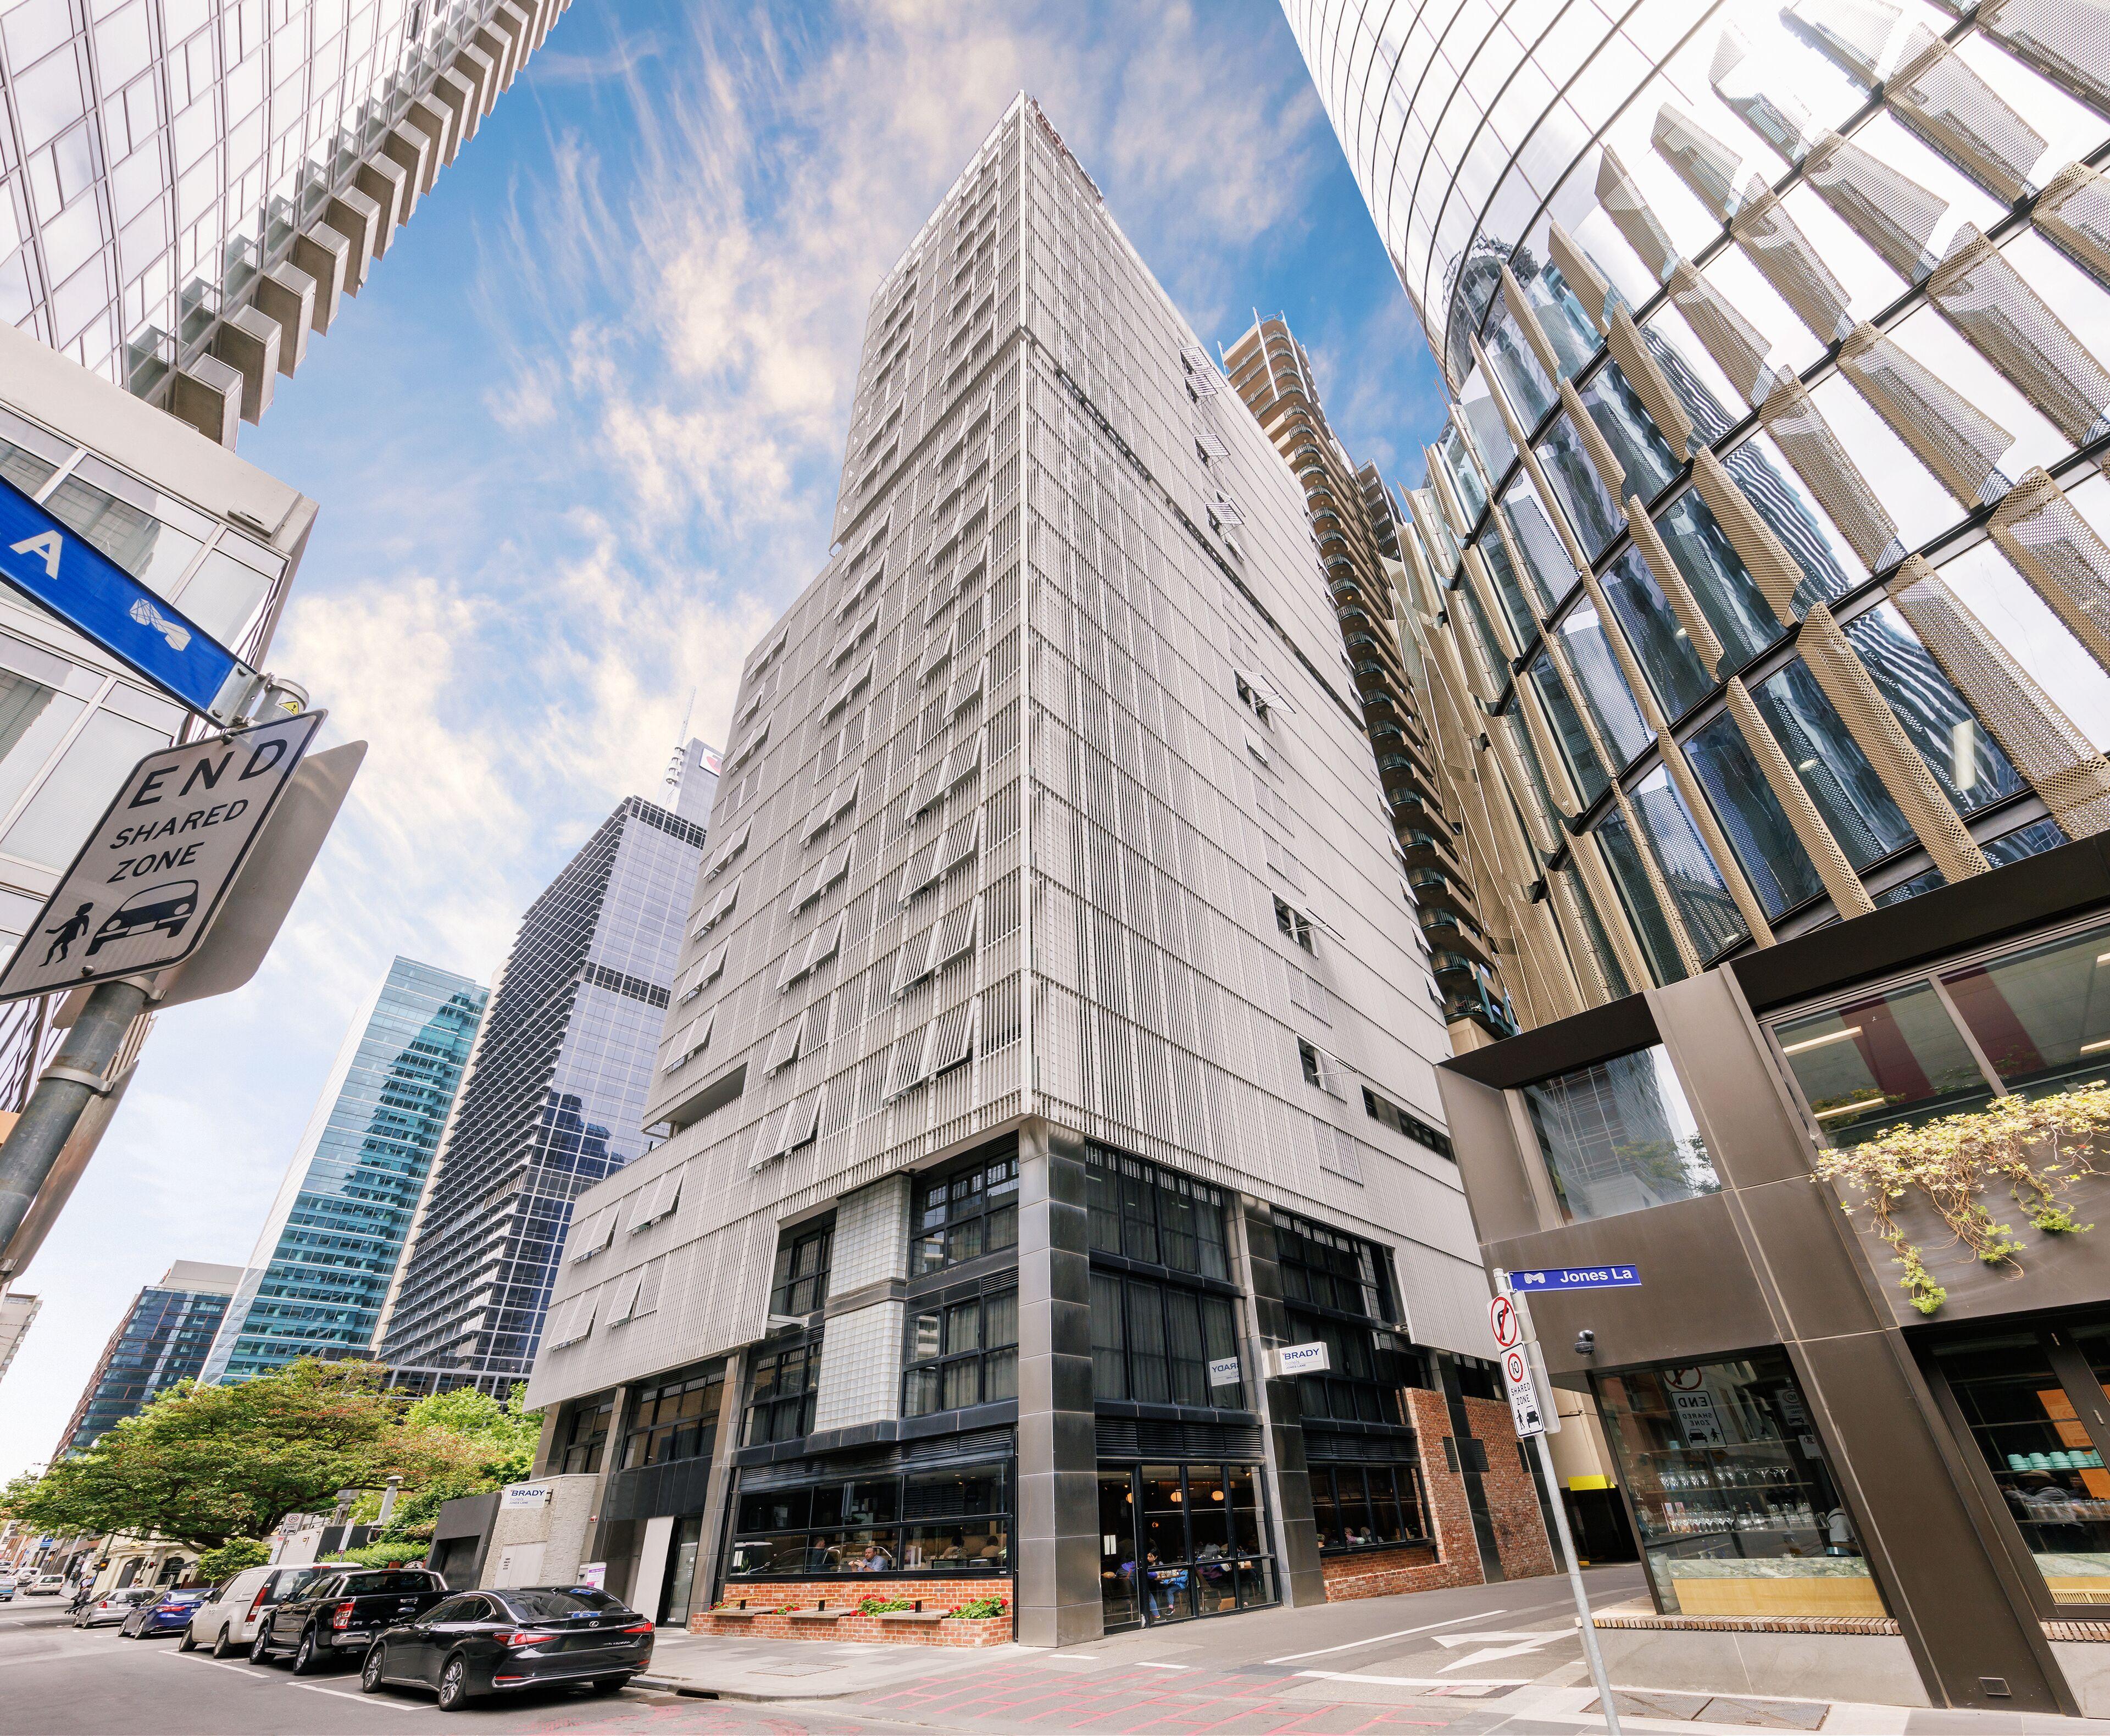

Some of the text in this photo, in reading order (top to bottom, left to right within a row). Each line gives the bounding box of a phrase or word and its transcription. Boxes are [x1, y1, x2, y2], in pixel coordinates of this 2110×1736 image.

[9, 529, 63, 580] A
[127, 739, 287, 809] END
[109, 799, 248, 850] SHARED
[106, 841, 205, 884] ZONE
[1560, 1268, 1633, 1283] Jones La
[1284, 1348, 1320, 1360] BRADY
[1511, 1361, 1519, 1375] 10
[1511, 1382, 1531, 1396] SHARED
[1516, 1394, 1530, 1406] ZONE
